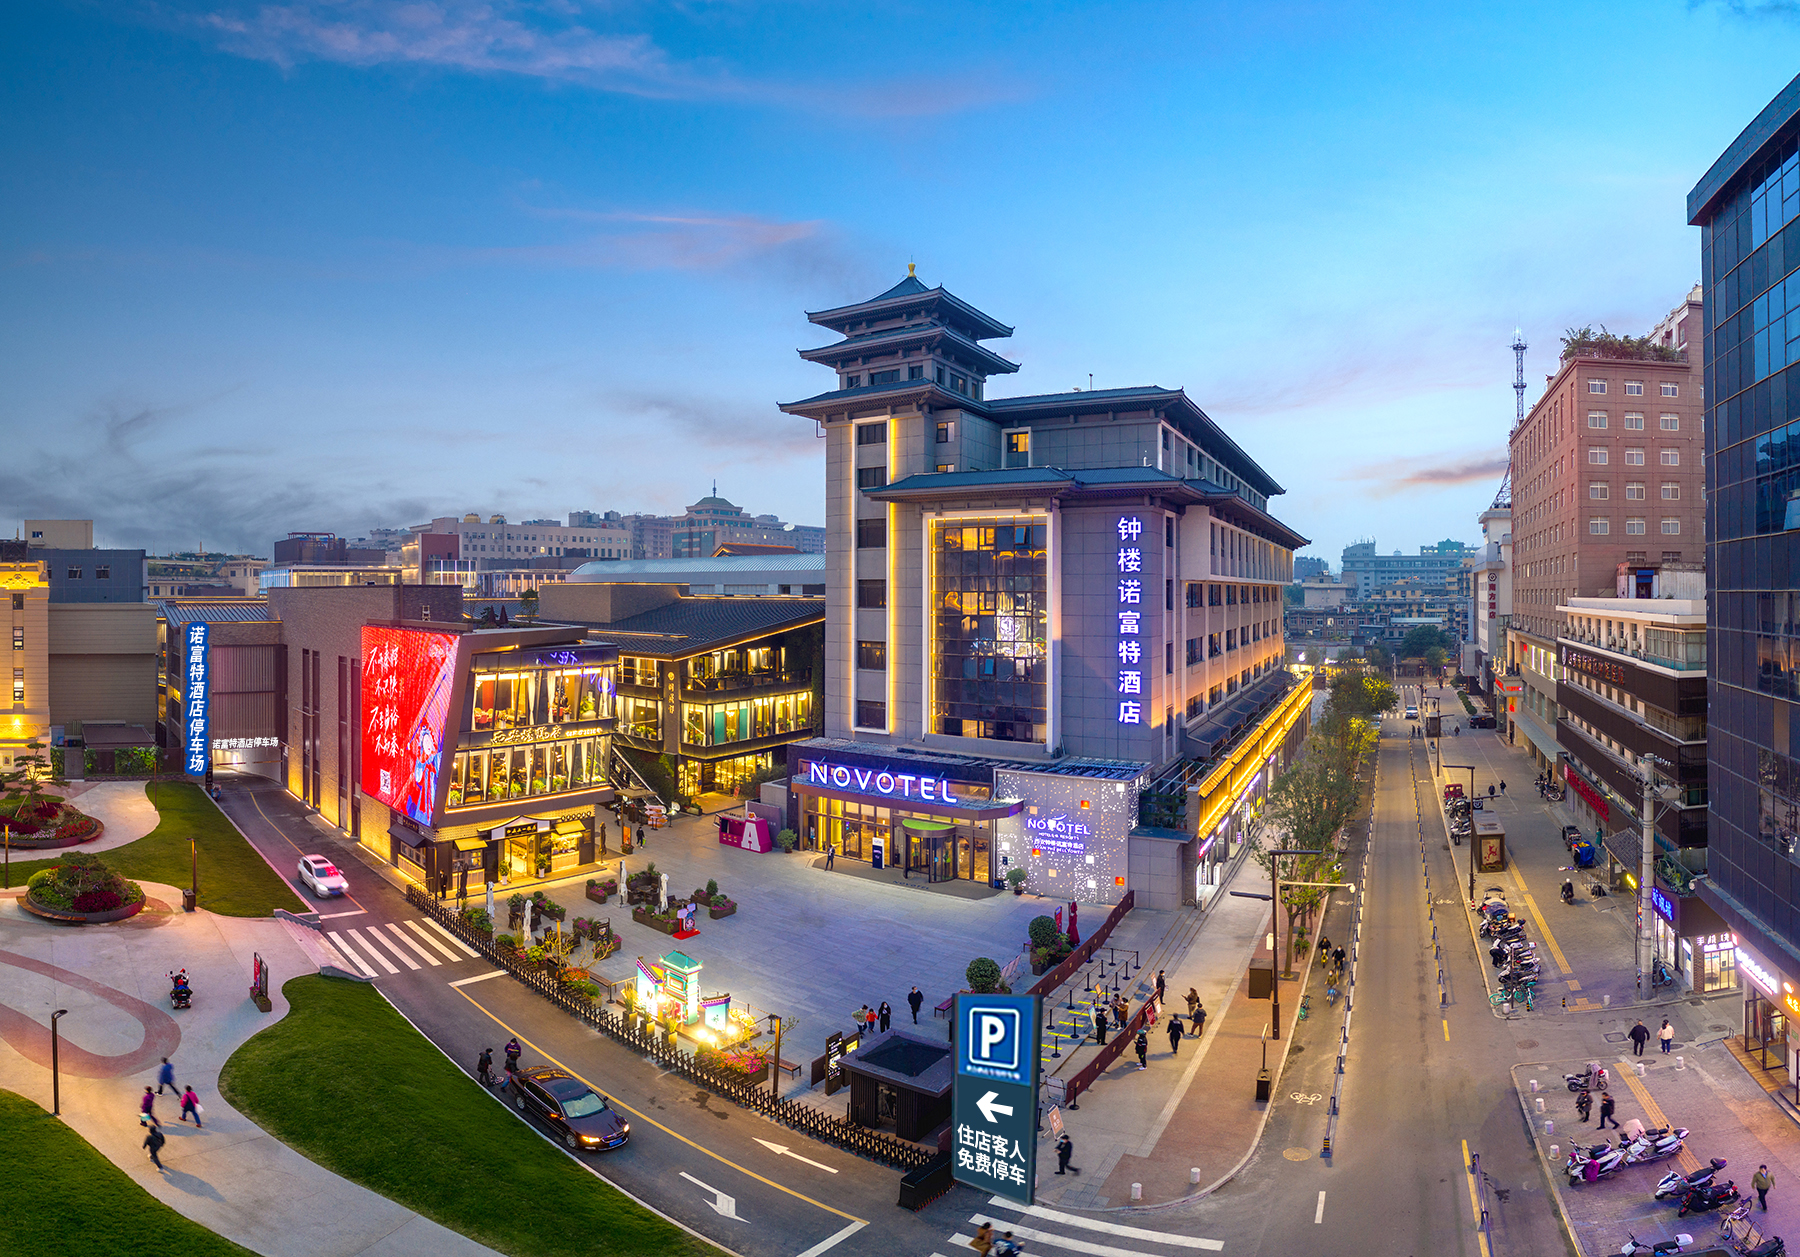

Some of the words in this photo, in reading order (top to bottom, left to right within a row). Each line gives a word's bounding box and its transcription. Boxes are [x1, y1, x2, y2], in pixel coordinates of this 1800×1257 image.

[1117, 516, 1142, 724] 钟楼诺富特酒店
[189, 626, 206, 772] 诺富特酒店停车场
[212, 736, 279, 750] 诺富特酒店停车场
[810, 762, 958, 803] NOVOTEL
[1027, 818, 1091, 836] NOVOTEL
[980, 1015, 1006, 1059] P
[957, 1123, 1026, 1163] 住店客人
[957, 1147, 1026, 1186] 免费停车
